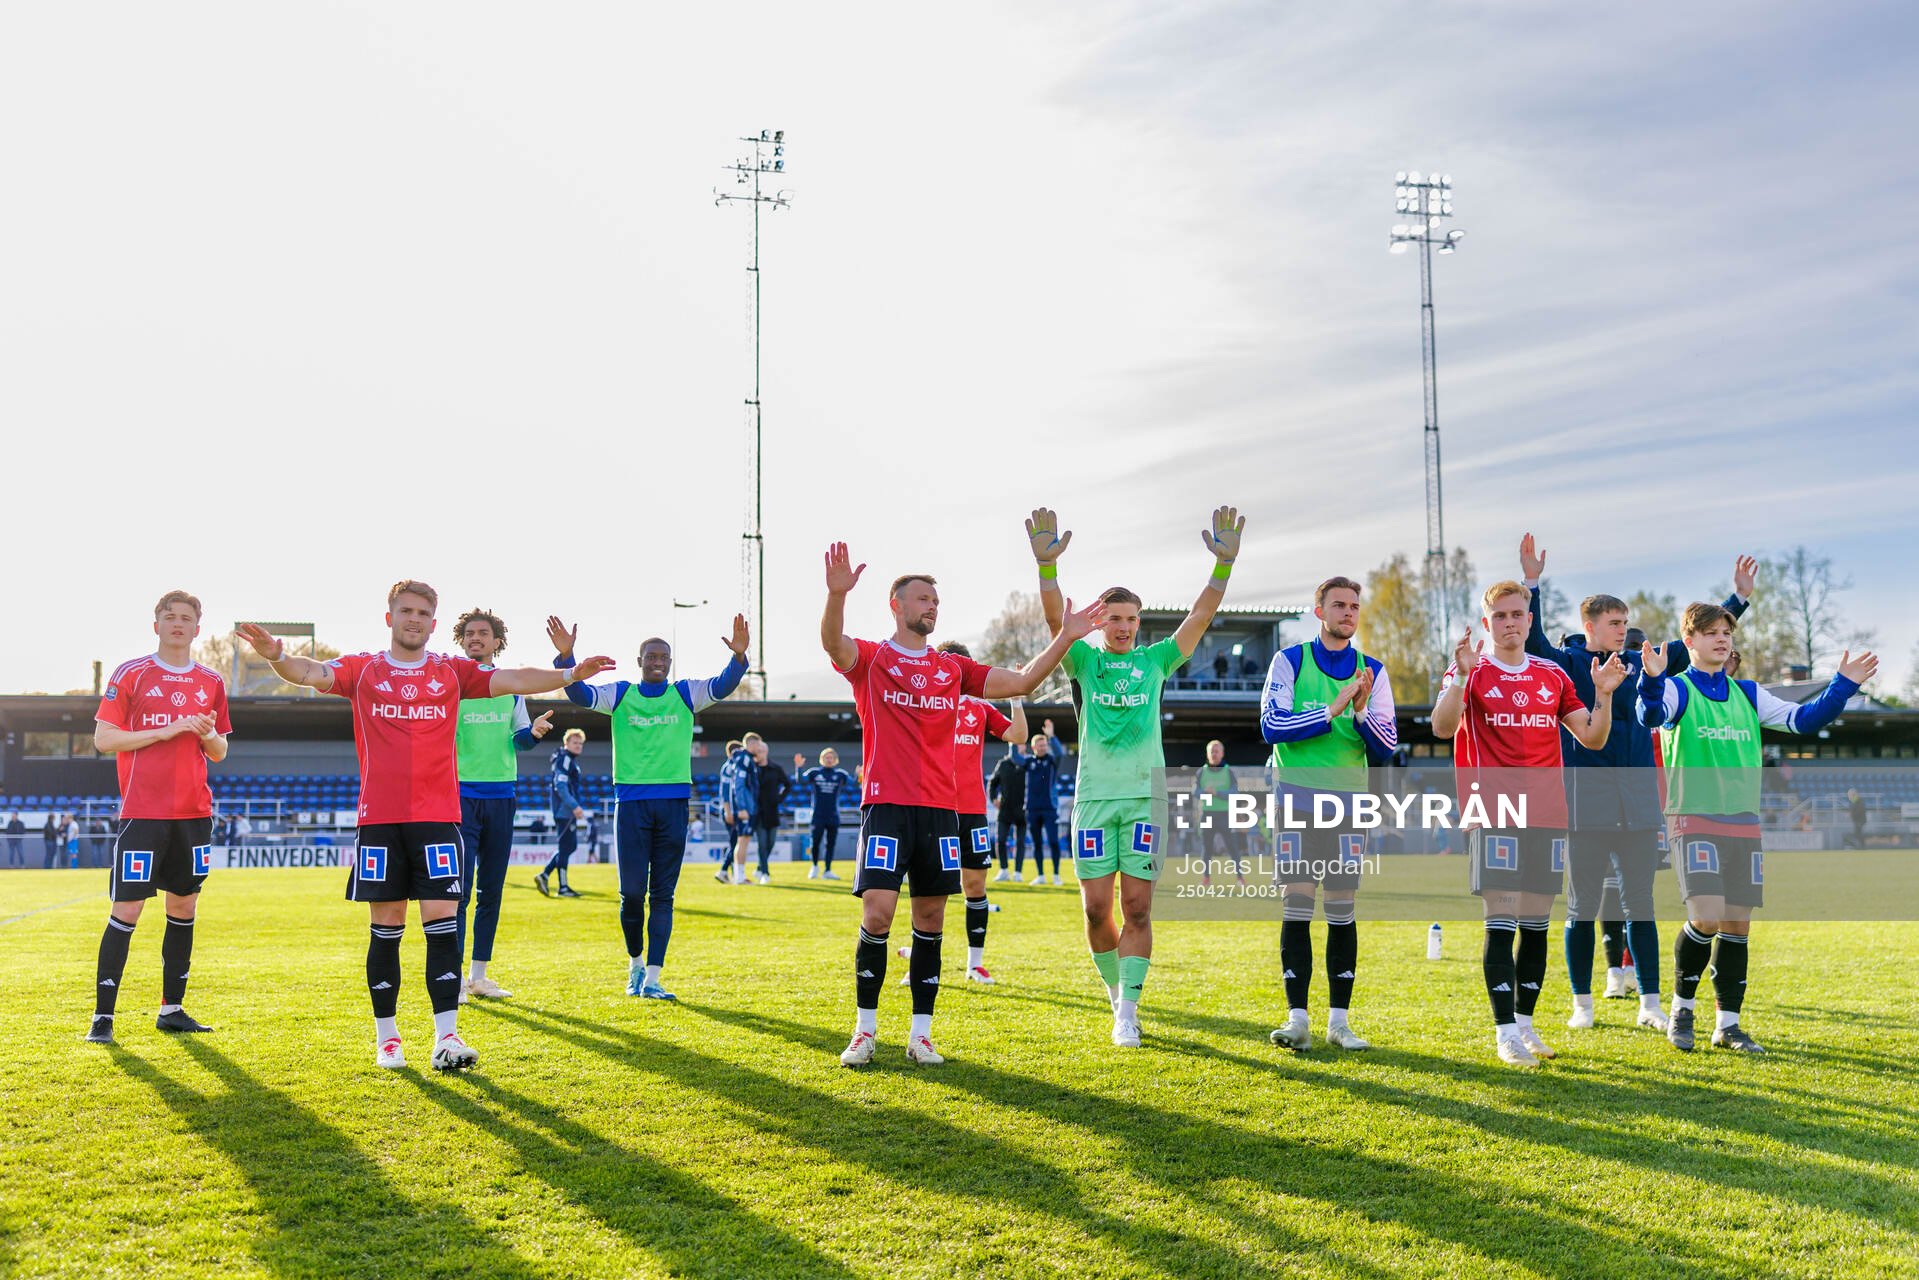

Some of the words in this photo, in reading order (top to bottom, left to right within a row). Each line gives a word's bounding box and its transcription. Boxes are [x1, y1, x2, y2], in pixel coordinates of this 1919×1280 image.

[390, 669, 425, 677] stadium
[883, 689, 955, 710] HOLMEN
[371, 703, 447, 720] HOLMEN
[1484, 713, 1557, 728] HOLMEN
[954, 734, 980, 745] MEN
[227, 848, 339, 867] FINNVEDEN
